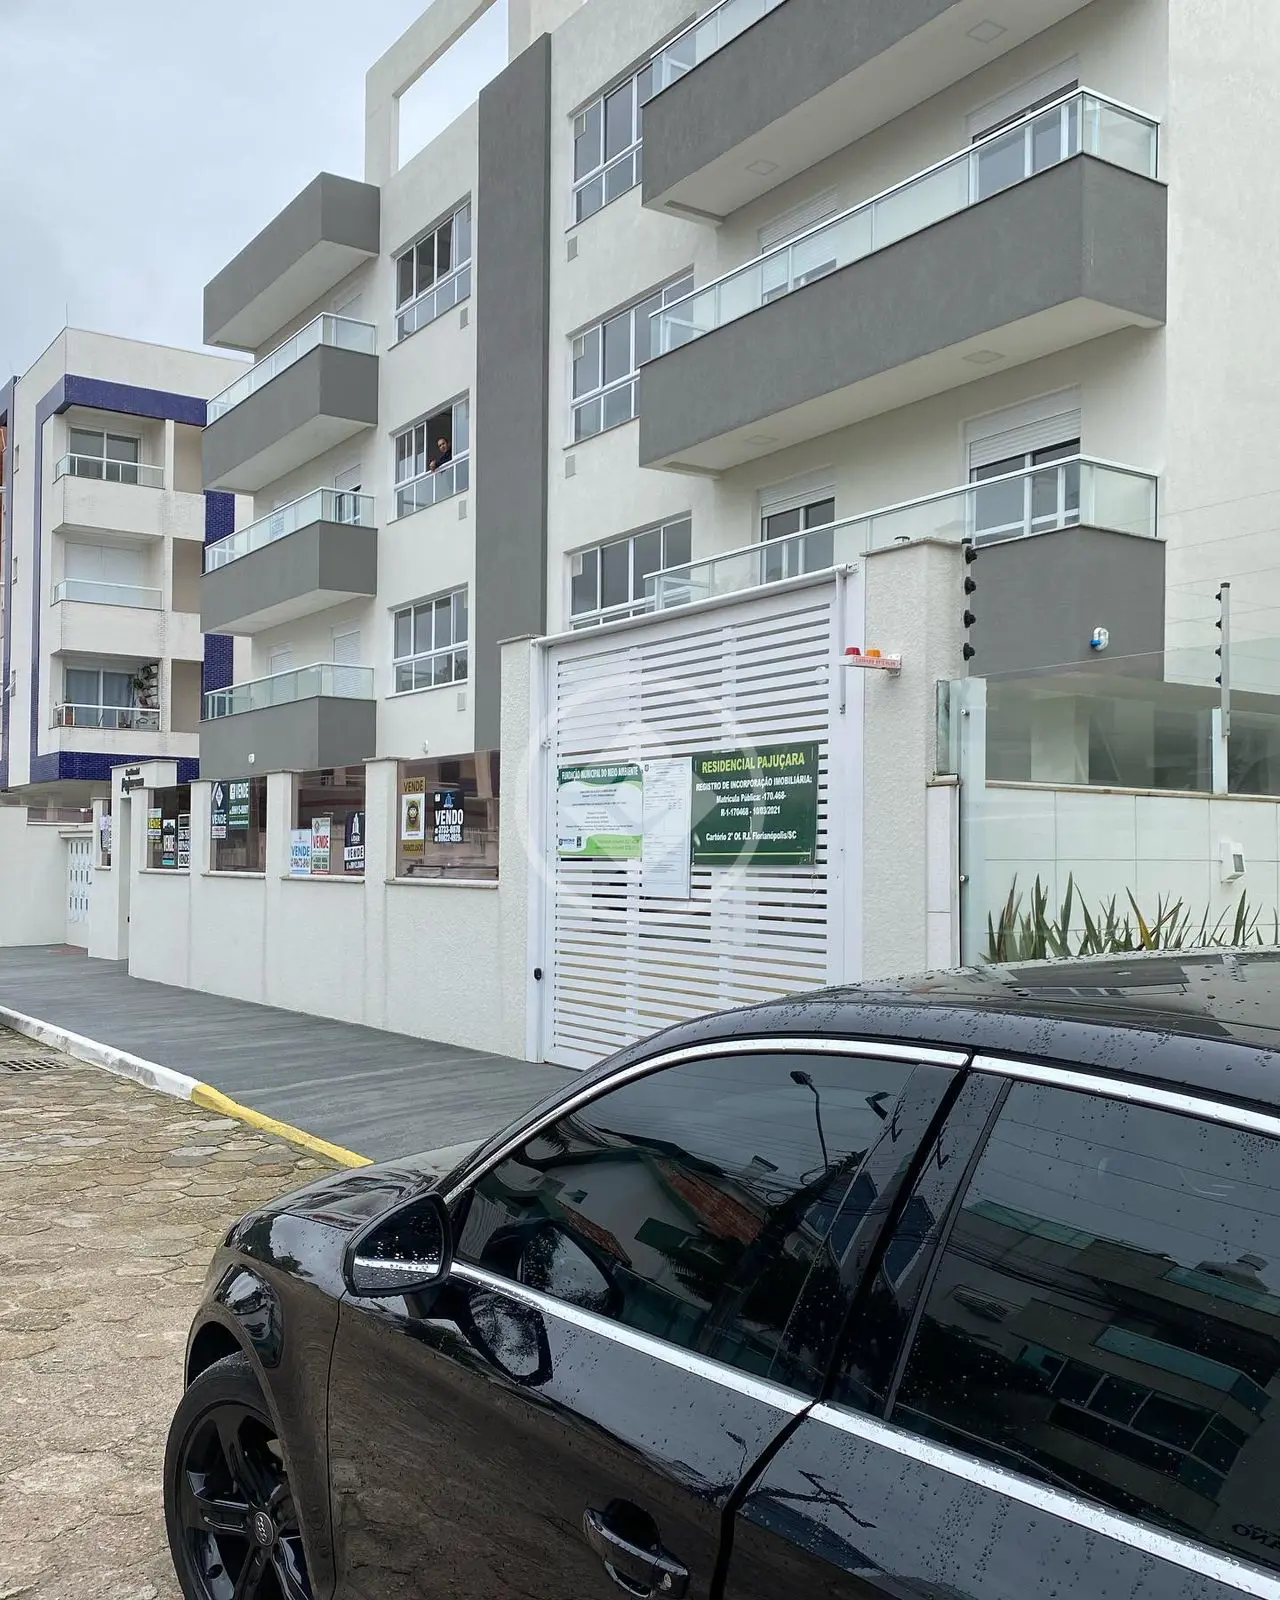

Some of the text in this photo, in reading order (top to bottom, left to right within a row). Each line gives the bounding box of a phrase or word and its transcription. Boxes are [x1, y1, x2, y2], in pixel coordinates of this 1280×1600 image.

[702, 758, 755, 774] RESIDENCIAL
[757, 752, 805, 770] PAJUÇARA
[404, 780, 424, 792] VENDE
[695, 774, 812, 792] REGISTRO DE INCORPORAÇÃO IMOBILIÁRIA:
[716, 794, 740, 803] Matrícula
[212, 814, 226, 825] VENDE
[435, 809, 464, 826] VENDO
[313, 835, 329, 849] VENDE
[705, 831, 727, 841] Cartório
[752, 830, 797, 842] Florianópolis/SC
[291, 845, 310, 857] VENDE
[347, 847, 364, 859] VENDE
